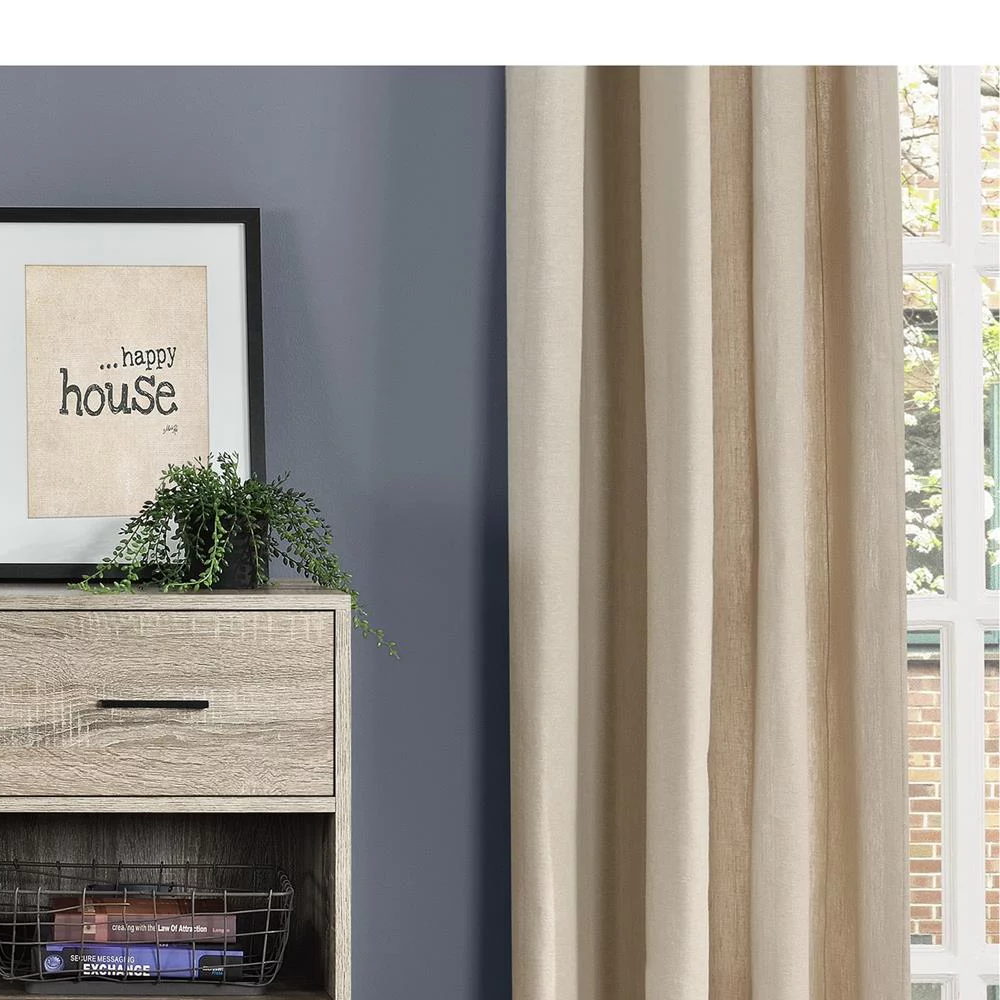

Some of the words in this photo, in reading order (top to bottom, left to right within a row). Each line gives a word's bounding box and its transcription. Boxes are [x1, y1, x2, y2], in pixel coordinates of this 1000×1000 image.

[59, 368, 178, 416] house
[112, 924, 134, 933] creaing
[136, 924, 147, 932] with
[148, 924, 156, 932] the
[158, 924, 170, 932] Law
[171, 924, 178, 932] Of
[83, 963, 150, 976] EXCHANGE
